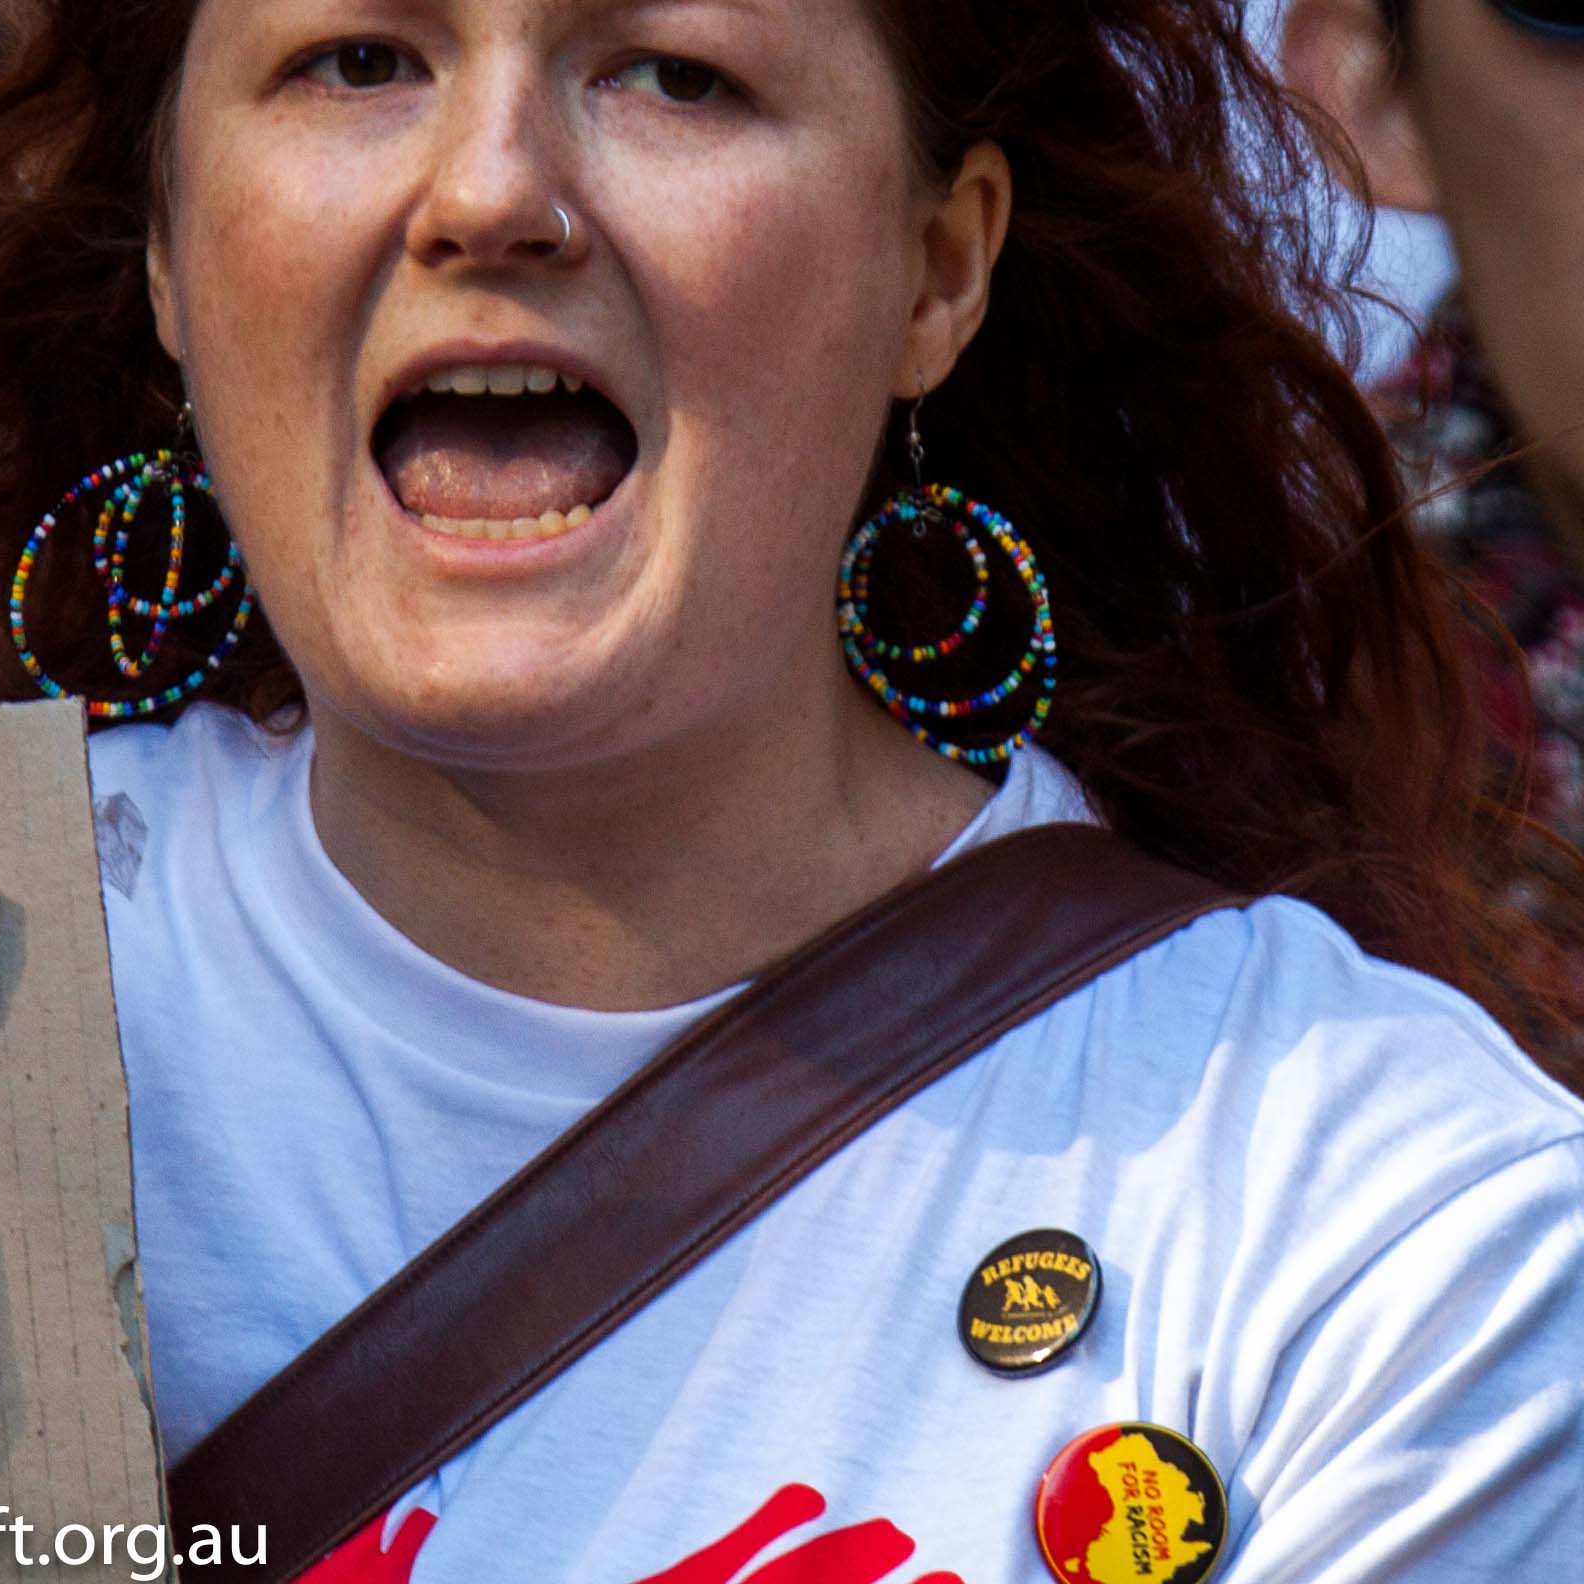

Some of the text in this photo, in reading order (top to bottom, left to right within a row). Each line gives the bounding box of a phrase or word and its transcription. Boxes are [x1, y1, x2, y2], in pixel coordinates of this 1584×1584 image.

[981, 1251, 1092, 1285] REFUGEES
[970, 1312, 1078, 1344] WELCOME
[1118, 1461, 1152, 1575] FOR RACISM
[1142, 1470, 1170, 1560] NO ROOM
